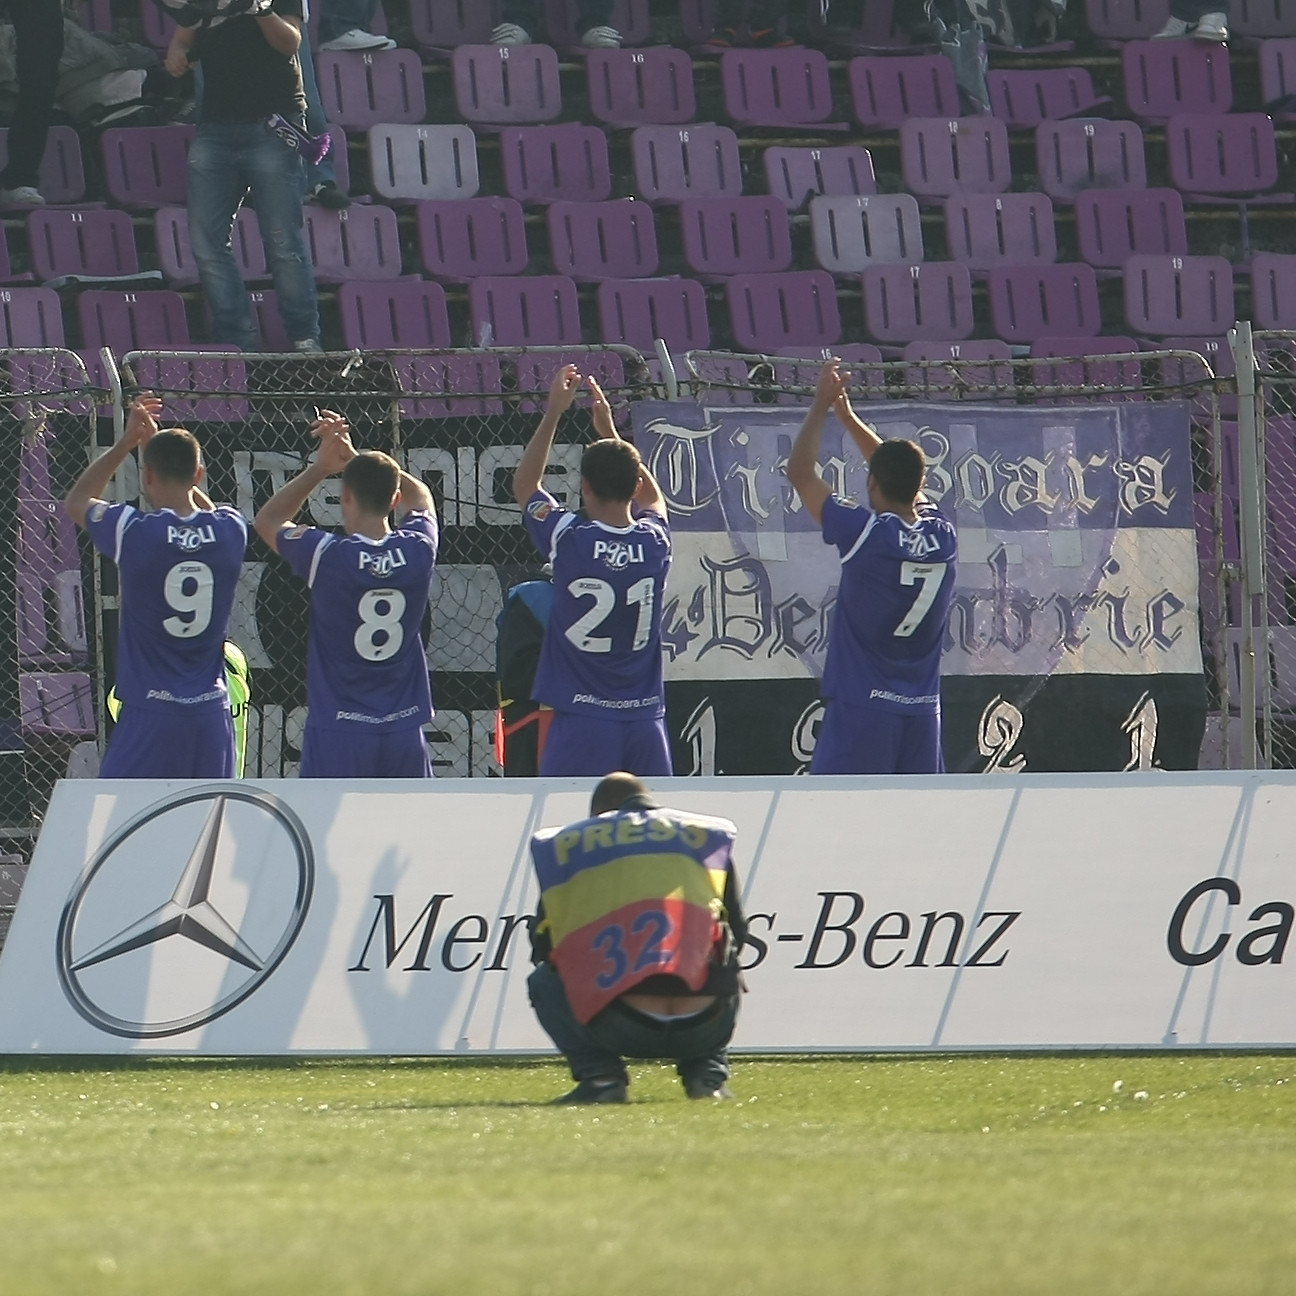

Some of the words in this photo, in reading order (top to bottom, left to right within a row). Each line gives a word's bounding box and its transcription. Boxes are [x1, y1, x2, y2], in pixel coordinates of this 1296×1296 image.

[631, 53, 645, 63] 16
[416, 128, 428, 139] 14
[810, 150, 821, 160] 17
[337, 209, 349, 221] 13
[909, 266, 920, 278] 17
[162, 560, 215, 639] 9
[353, 588, 407, 663] 8
[562, 577, 655, 654] 21
[892, 560, 948, 638] 7
[552, 817, 707, 866] PRESS
[347, 890, 1023, 972] Mers-Benz
[591, 909, 675, 992] 32
